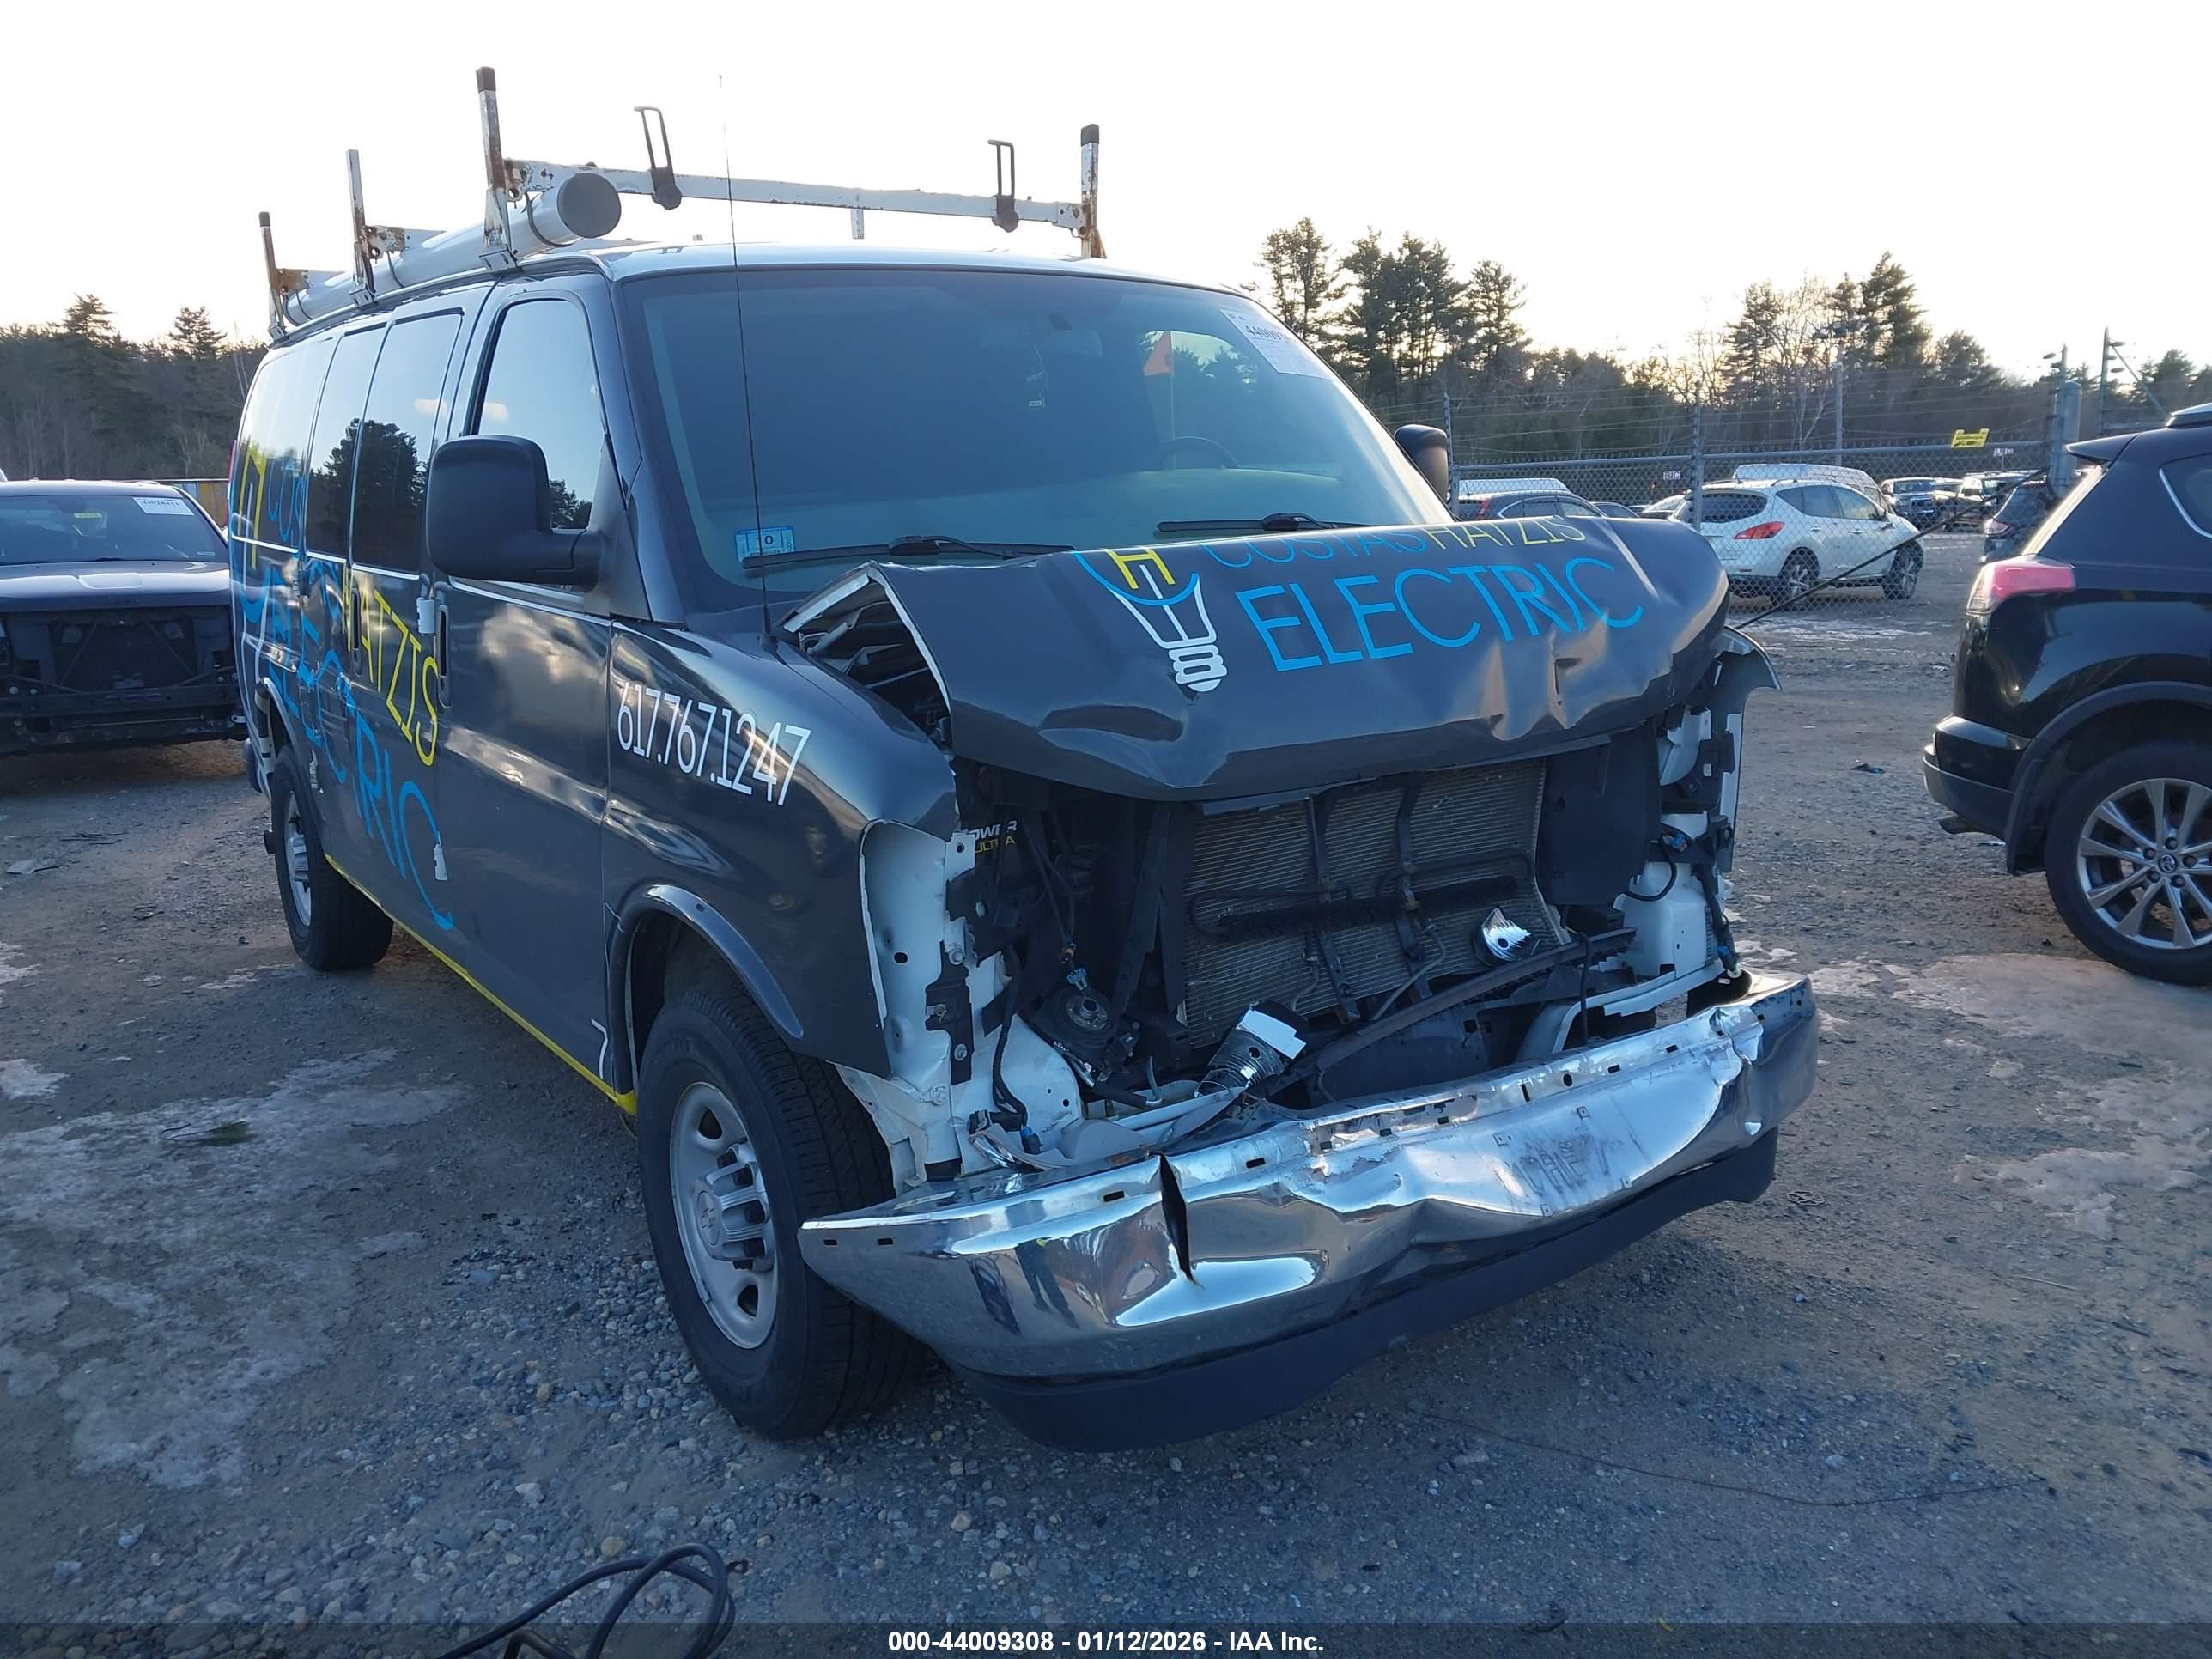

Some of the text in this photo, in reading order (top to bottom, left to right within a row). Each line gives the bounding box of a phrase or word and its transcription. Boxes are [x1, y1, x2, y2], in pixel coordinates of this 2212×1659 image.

[343, 558, 439, 766] HATZIS
[1236, 557, 1643, 672] ELECTRIC
[617, 681, 811, 806] 617.767.1247
[975, 835, 1016, 854] ULTA
